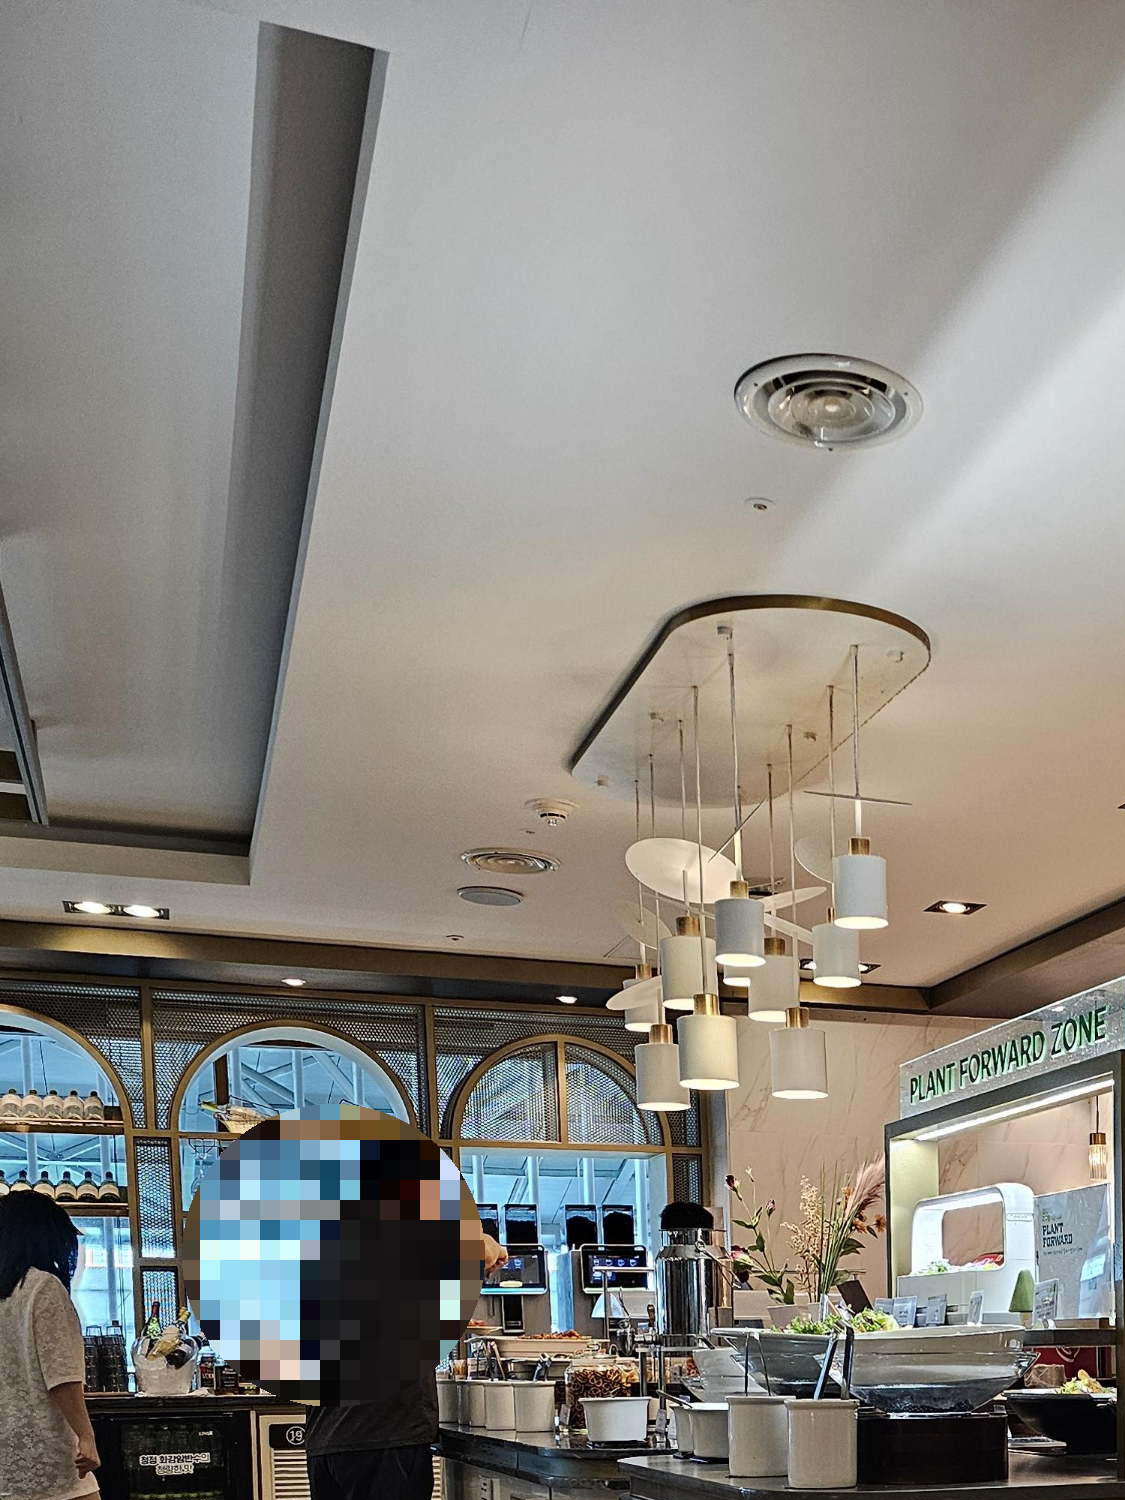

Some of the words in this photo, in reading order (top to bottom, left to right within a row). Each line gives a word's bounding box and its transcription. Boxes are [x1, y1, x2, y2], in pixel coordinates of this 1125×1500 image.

[910, 1062, 956, 1104] PLANT
[960, 1030, 1046, 1088] FORWARD
[1051, 1006, 1107, 1058] ZONE
[1042, 1222, 1064, 1236] PLANT
[1042, 1233, 1073, 1248] FORWARD
[289, 1430, 303, 1442] 19
